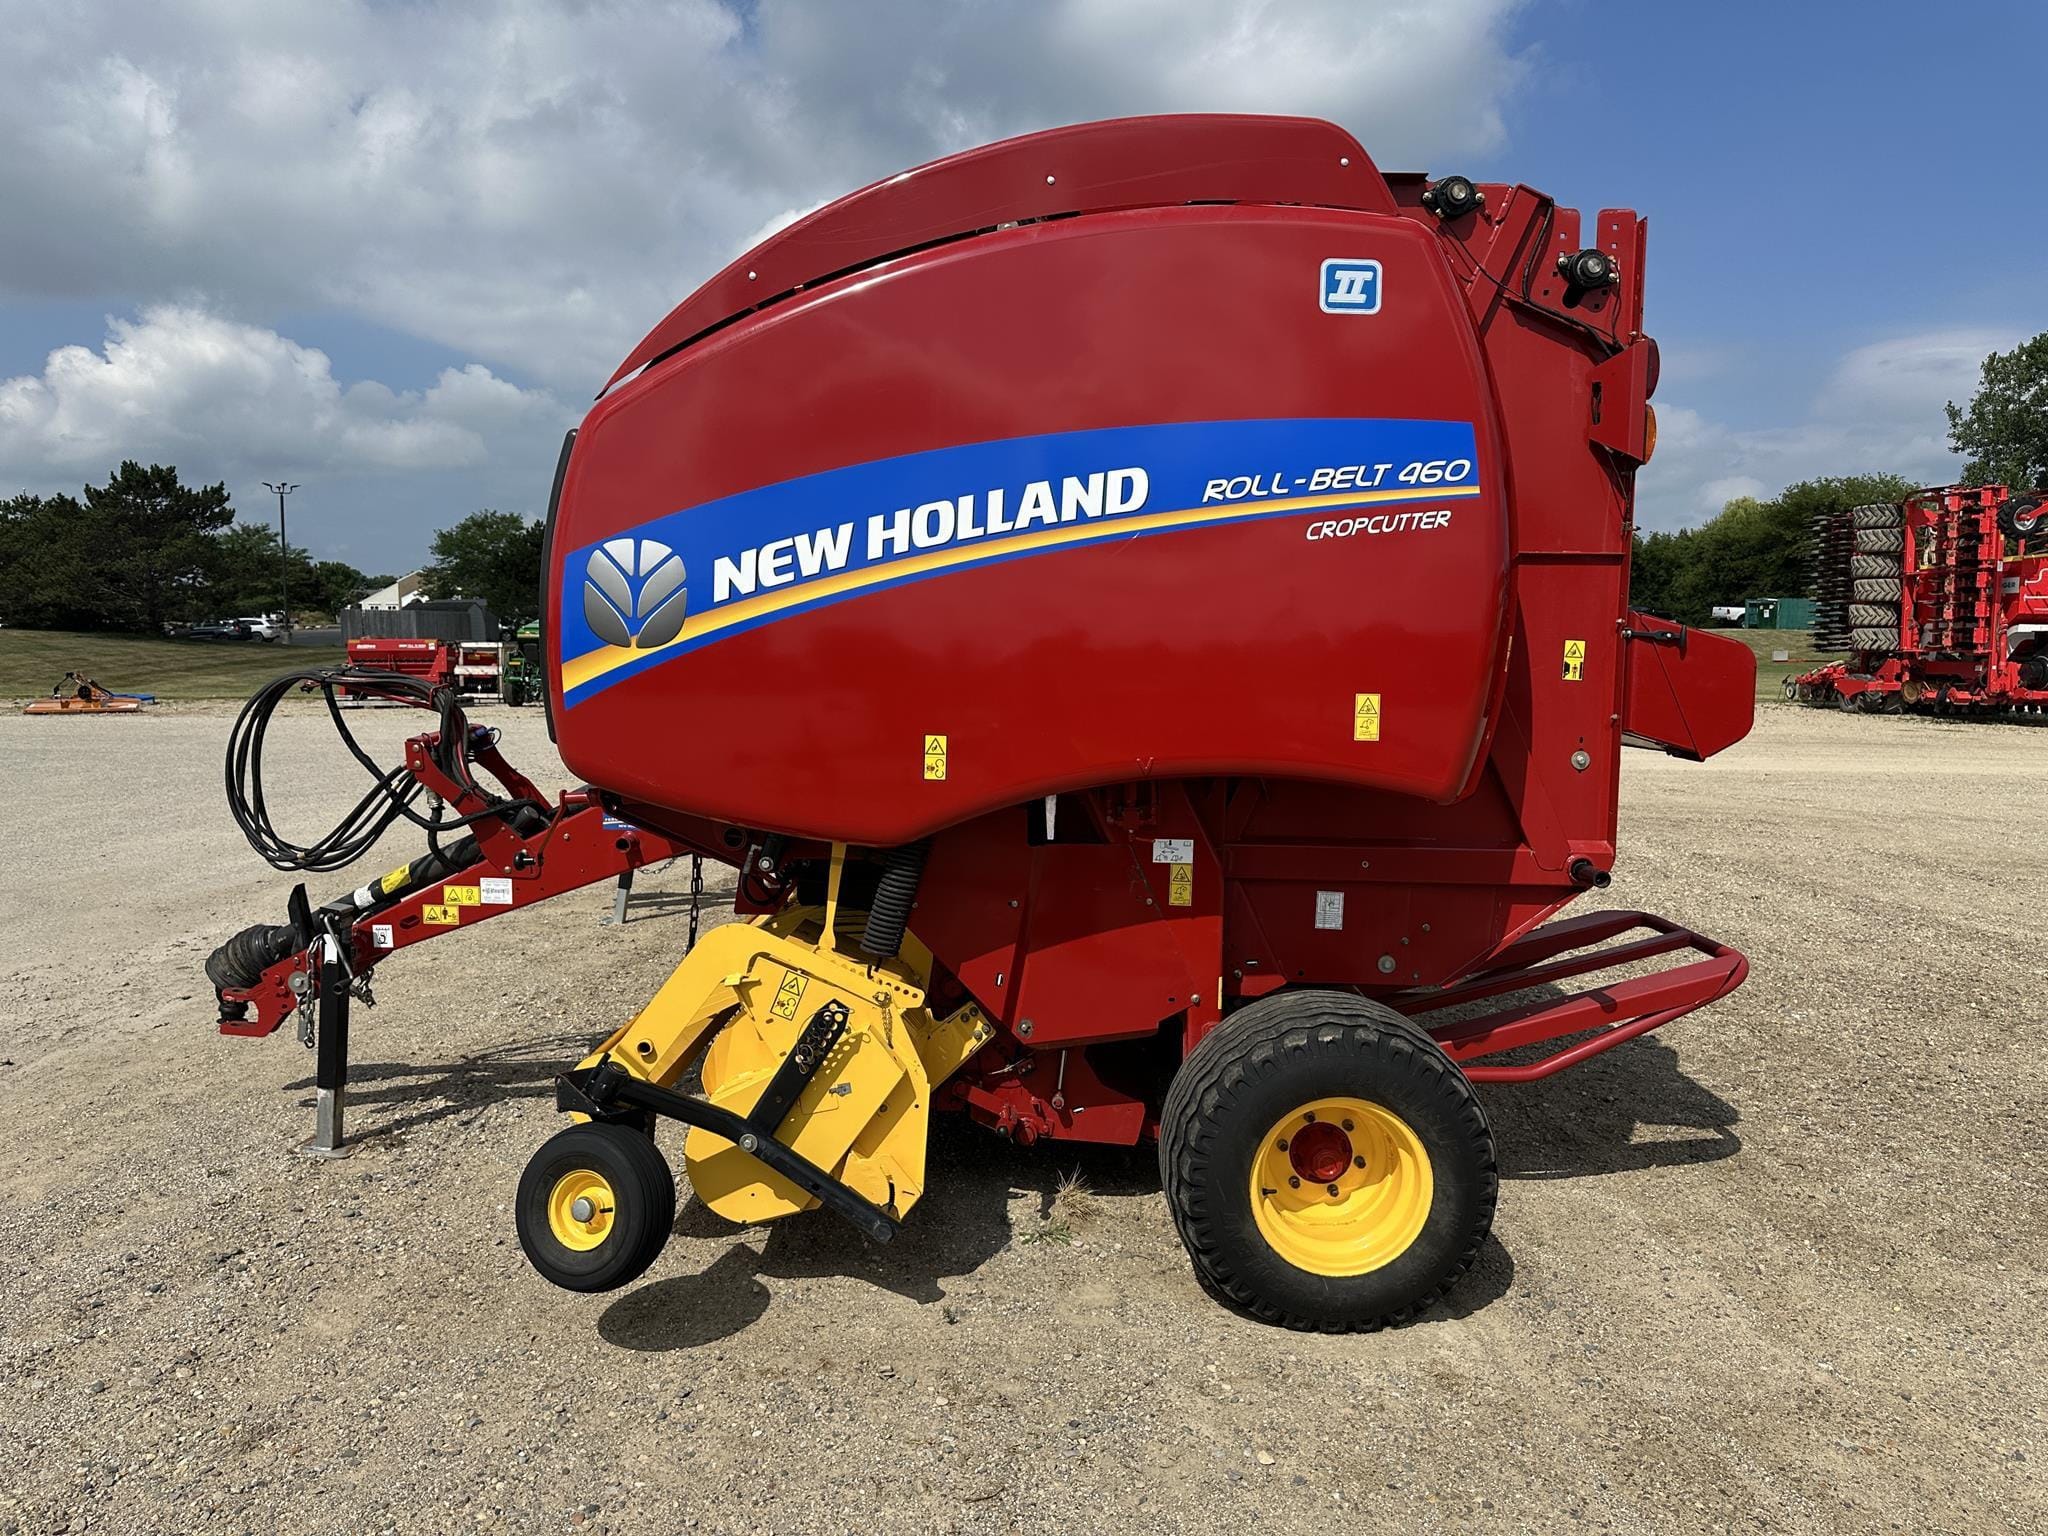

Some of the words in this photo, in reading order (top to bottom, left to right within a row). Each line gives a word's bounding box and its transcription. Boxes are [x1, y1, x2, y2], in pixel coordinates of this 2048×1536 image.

[1202, 463, 1393, 503] ROLL-BELT
[1398, 459, 1471, 485] 460
[713, 522, 854, 603] NEW
[867, 467, 1149, 560] HOLLAND
[1306, 510, 1451, 540] CROPCUTTER
